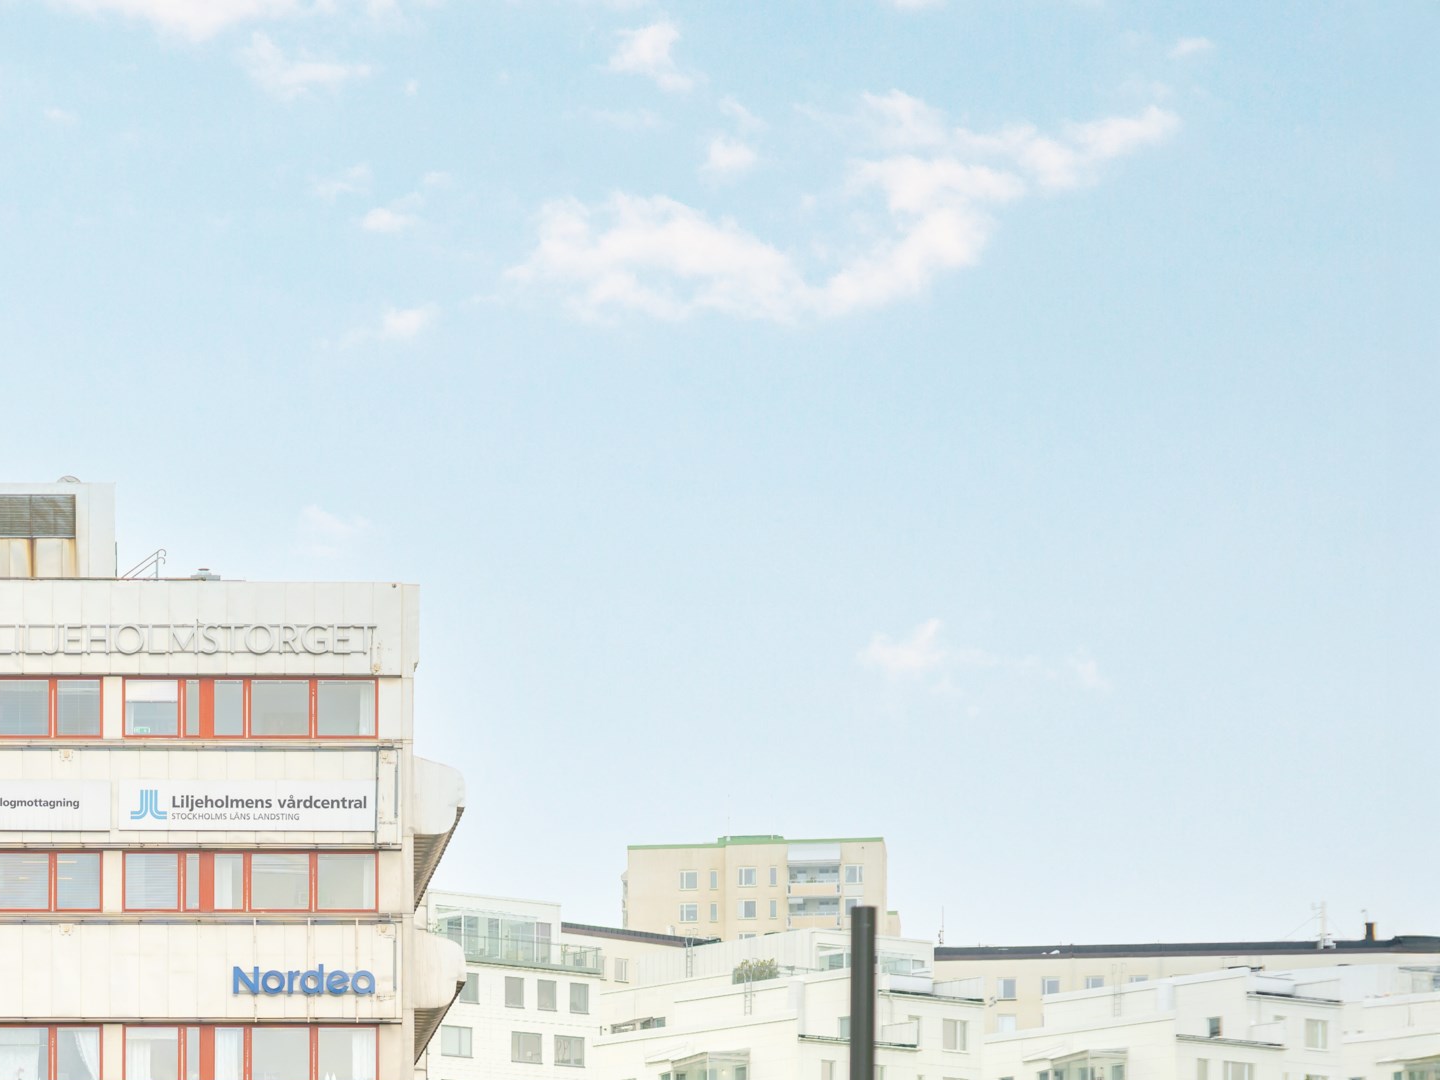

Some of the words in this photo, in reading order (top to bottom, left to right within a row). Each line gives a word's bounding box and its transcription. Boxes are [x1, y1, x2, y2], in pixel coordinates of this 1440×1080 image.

[171, 795, 273, 811] Liljeholmens
[277, 794, 367, 809] vårdcentral
[171, 812, 228, 820] STOCKHOLMS
[253, 813, 300, 821] LANDSTING
[232, 963, 376, 995] Nordea
